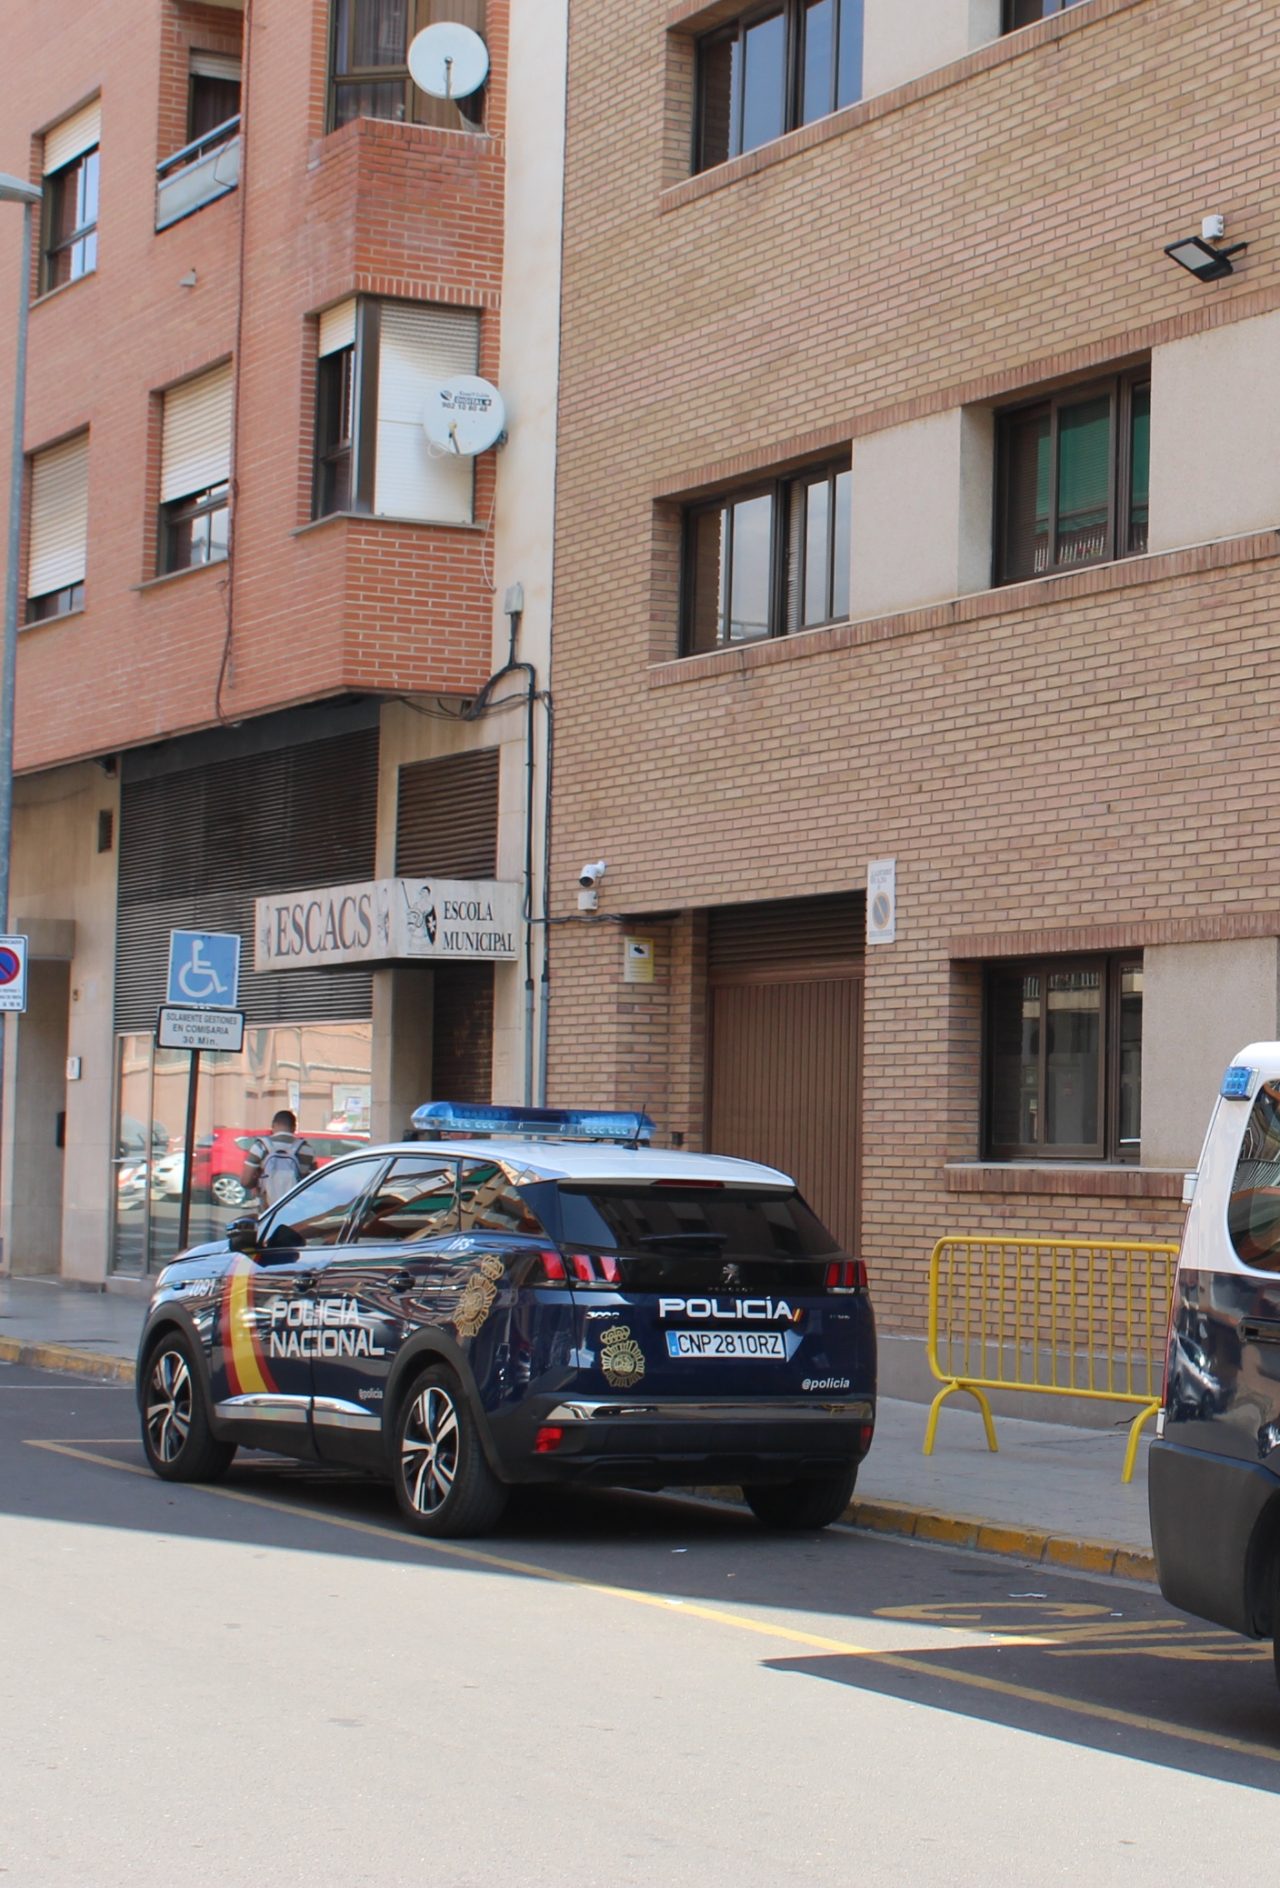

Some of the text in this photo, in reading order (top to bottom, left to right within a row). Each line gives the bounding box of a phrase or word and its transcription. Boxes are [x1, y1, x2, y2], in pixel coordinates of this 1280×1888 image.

[444, 900, 494, 921] ESCOLA
[274, 894, 372, 957] ESCACS
[443, 931, 516, 952] MUNICIPAL
[166, 1012, 237, 1025] SOLAMENTE GESTIONES
[172, 1024, 184, 1033] EN
[183, 1036, 194, 1044] 30
[658, 1296, 793, 1320] POLICÍA
[270, 1328, 385, 1358] NACIONAL
[801, 1377, 850, 1391] @policia
